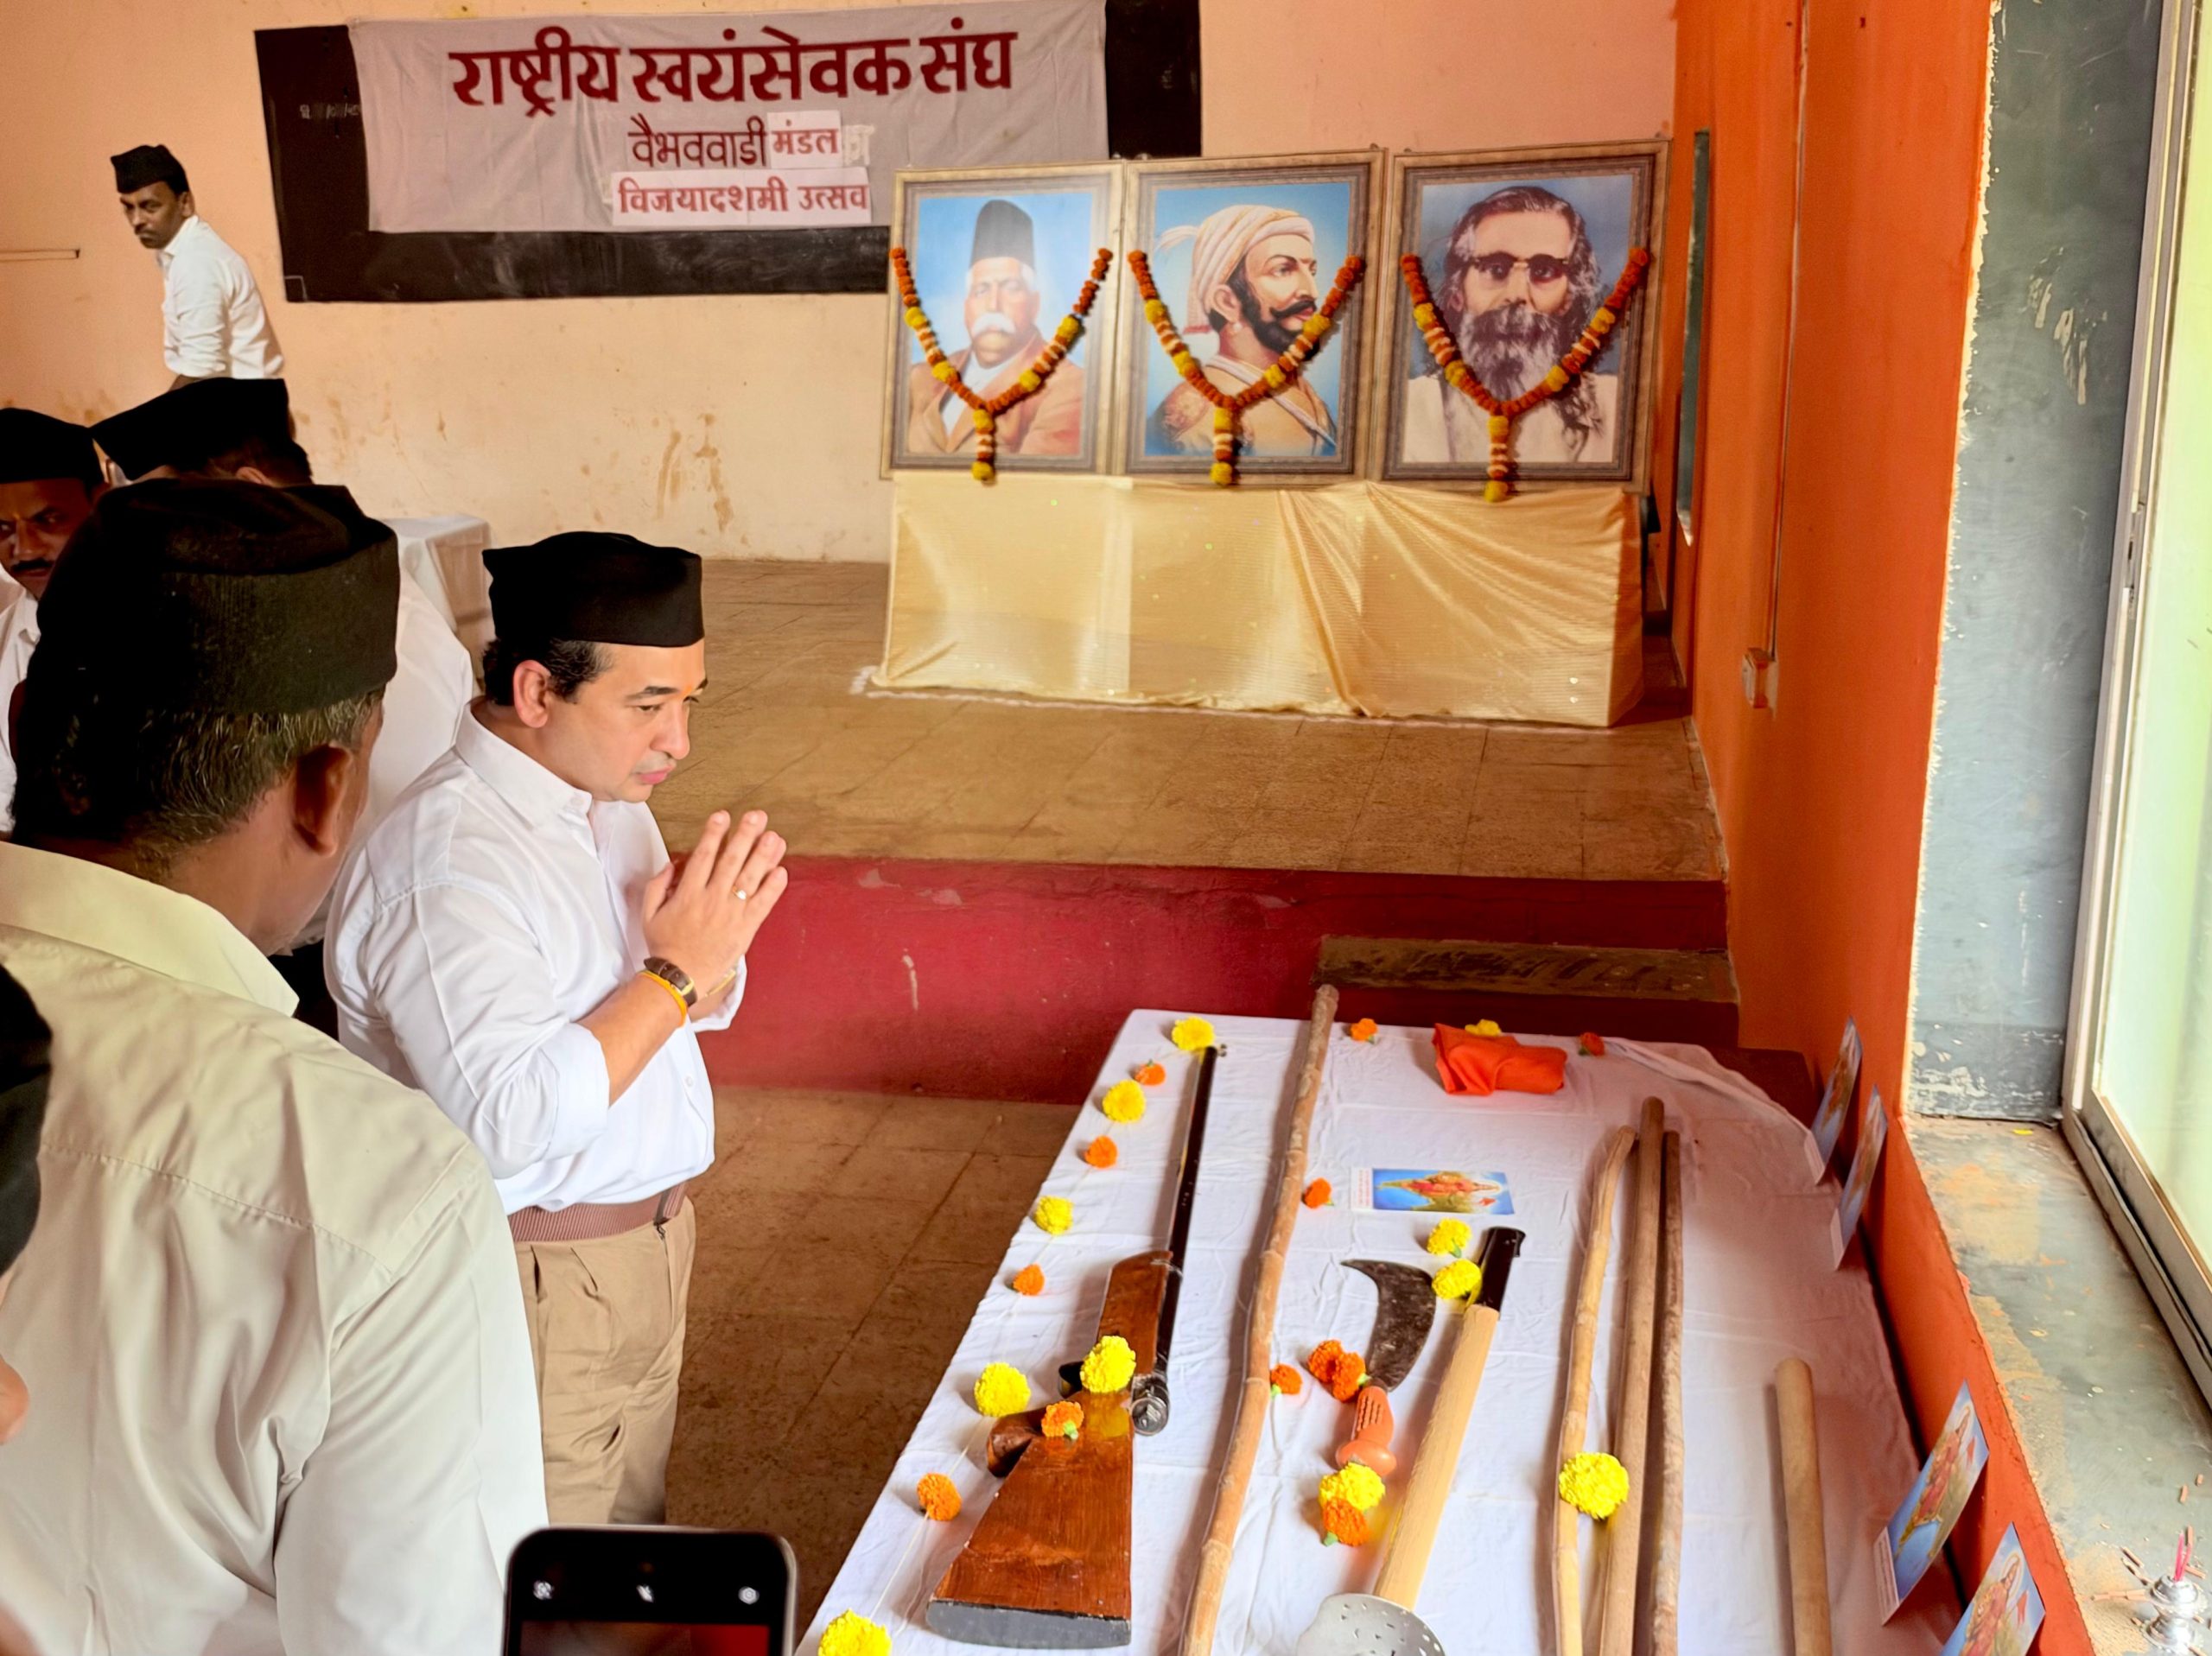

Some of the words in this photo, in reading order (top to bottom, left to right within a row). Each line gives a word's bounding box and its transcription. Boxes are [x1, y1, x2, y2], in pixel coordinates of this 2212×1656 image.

[448, 26, 620, 117] राष्ट्रीय
[629, 26, 912, 102] स्वयंसेवक
[918, 16, 1019, 94] संघ
[628, 113, 767, 167] वैभववाडी
[772, 119, 839, 155] मंडल
[618, 176, 788, 213] विजयादशमी
[797, 184, 869, 211] उत्सव
